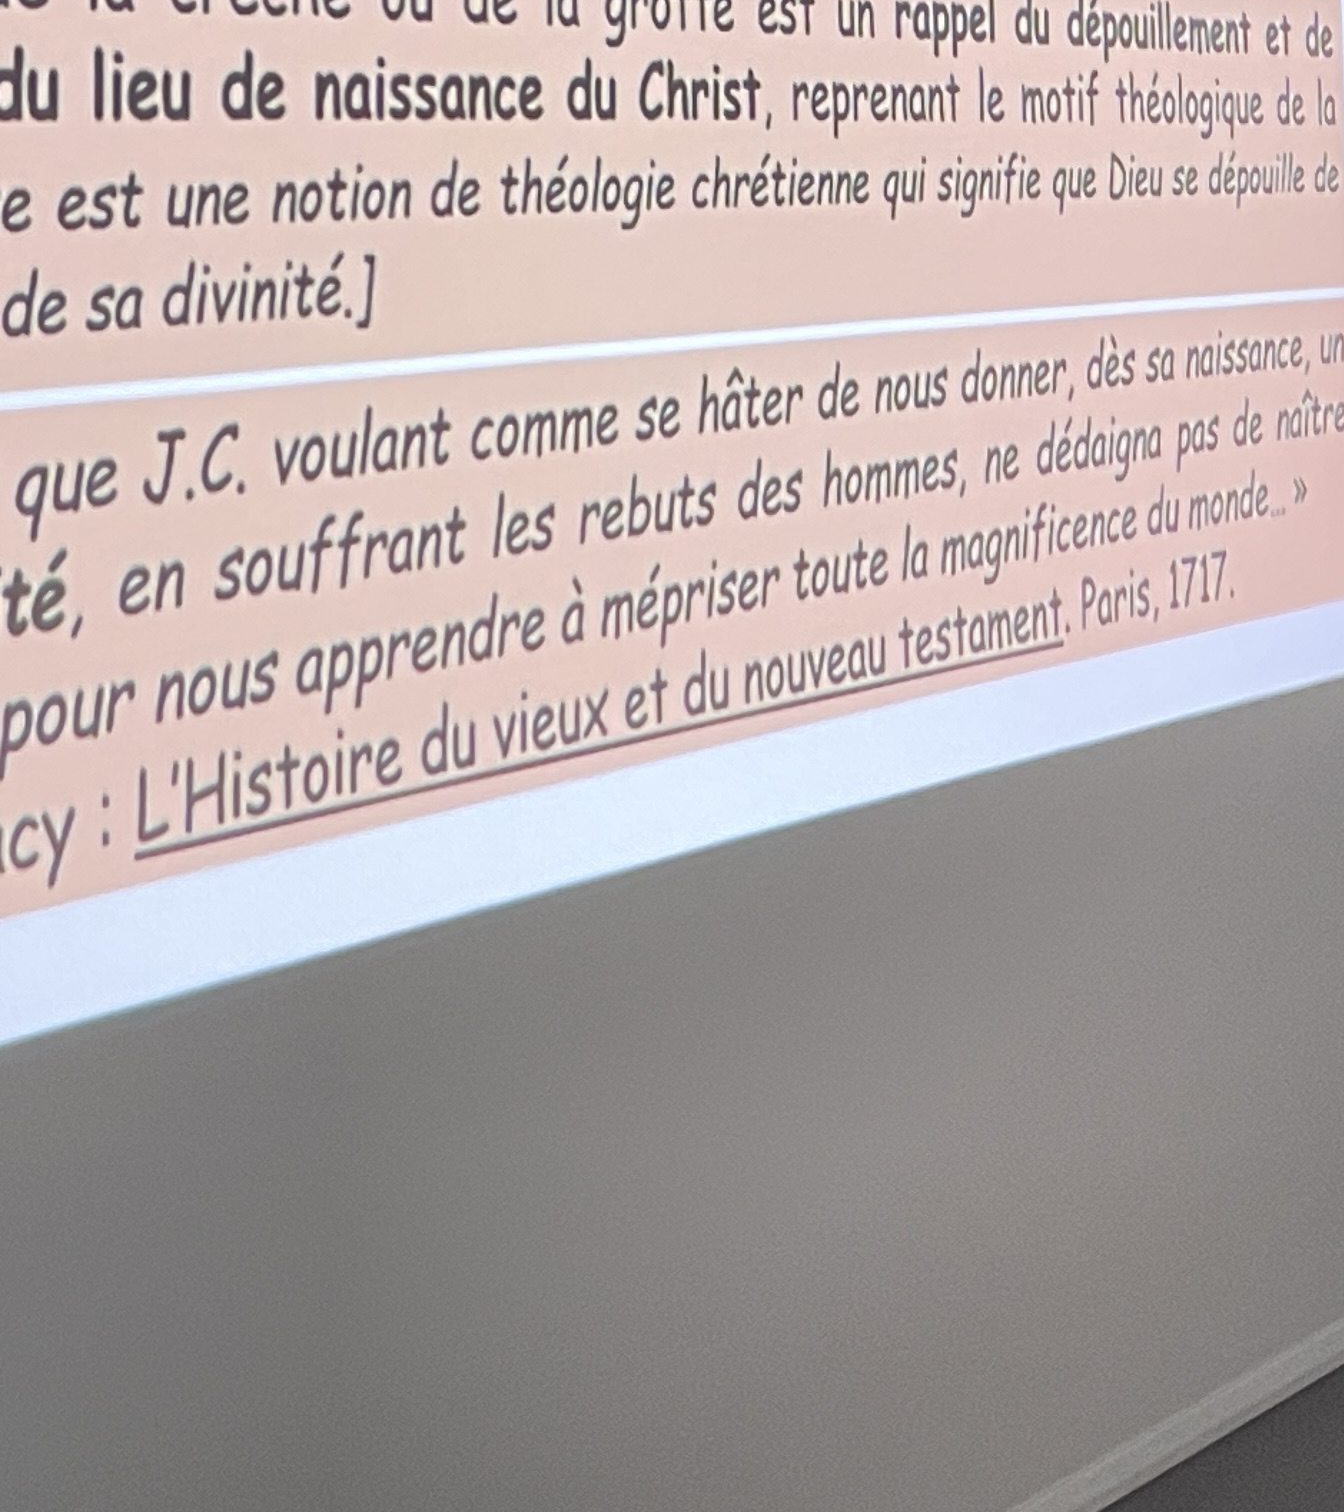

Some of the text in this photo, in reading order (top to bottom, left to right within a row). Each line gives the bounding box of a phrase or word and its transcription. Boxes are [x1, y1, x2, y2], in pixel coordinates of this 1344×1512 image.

[93, 44, 1336, 141] lieu de naissance du Christ, reprenant le motif théologique de la
[1265, 14, 1292, 56] et
[1305, 10, 1333, 58] de
[56, 149, 1306, 232] est une notion de théologie chrétienne qui signifie que Dieu dépouille
[1, 250, 377, 339] de sa divinité.]
[14, 456, 119, 543] que
[142, 421, 246, 506] J.C.
[273, 404, 452, 486] voulant
[470, 403, 620, 461] comme
[634, 394, 681, 442] se
[697, 365, 804, 435] hâter
[817, 360, 861, 421] de
[874, 365, 949, 415] nous
[960, 347, 1075, 404] donner,
[1086, 333, 1136, 390] dès
[1145, 346, 1175, 383] sa
[118, 559, 186, 616] en
[213, 505, 468, 602] souffrant
[492, 489, 556, 559] les
[579, 472, 717, 545] rebuts
[737, 456, 804, 521] des
[823, 447, 967, 509] hommes,
[984, 443, 1020, 485] ne
[1036, 415, 1162, 483] dédaigna
[1176, 414, 1220, 473] pas
[1232, 397, 1264, 447] de
[0, 483, 1180, 783] pour nous apprendre à mépriser toute la magnificence du
[137, 727, 403, 843] L'Histoire
[420, 700, 476, 776] du
[492, 687, 609, 760] vieux
[624, 667, 669, 730] et
[683, 647, 730, 717] du
[744, 634, 886, 705] nouveau
[897, 586, 1071, 669] testament.
